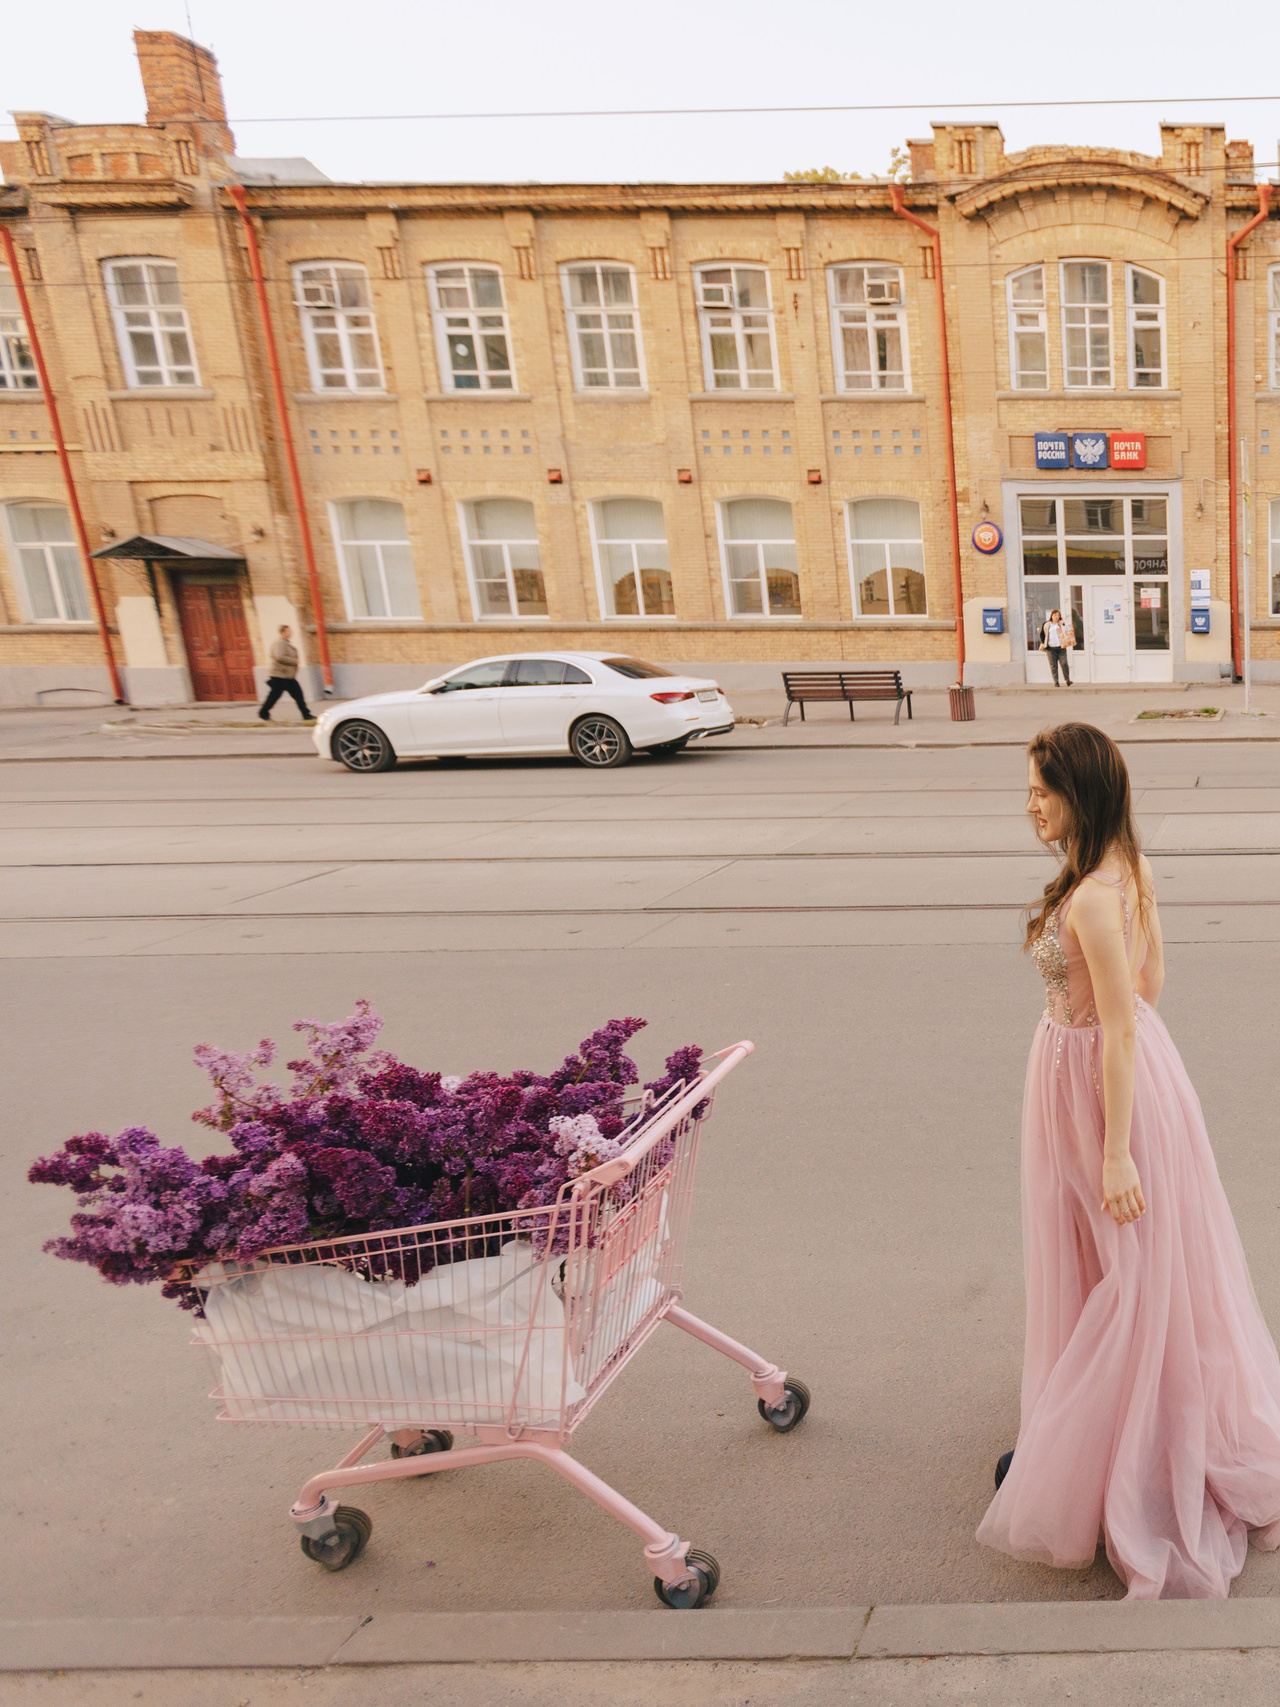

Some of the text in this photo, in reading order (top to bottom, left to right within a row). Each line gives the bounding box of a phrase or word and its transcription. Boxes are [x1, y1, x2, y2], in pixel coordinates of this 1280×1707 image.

[1037, 441, 1065, 450] ПОЧТА
[1114, 441, 1141, 450] ПОЧТА
[1038, 451, 1066, 460] РОССИИ
[1114, 452, 1139, 460] БАНК
